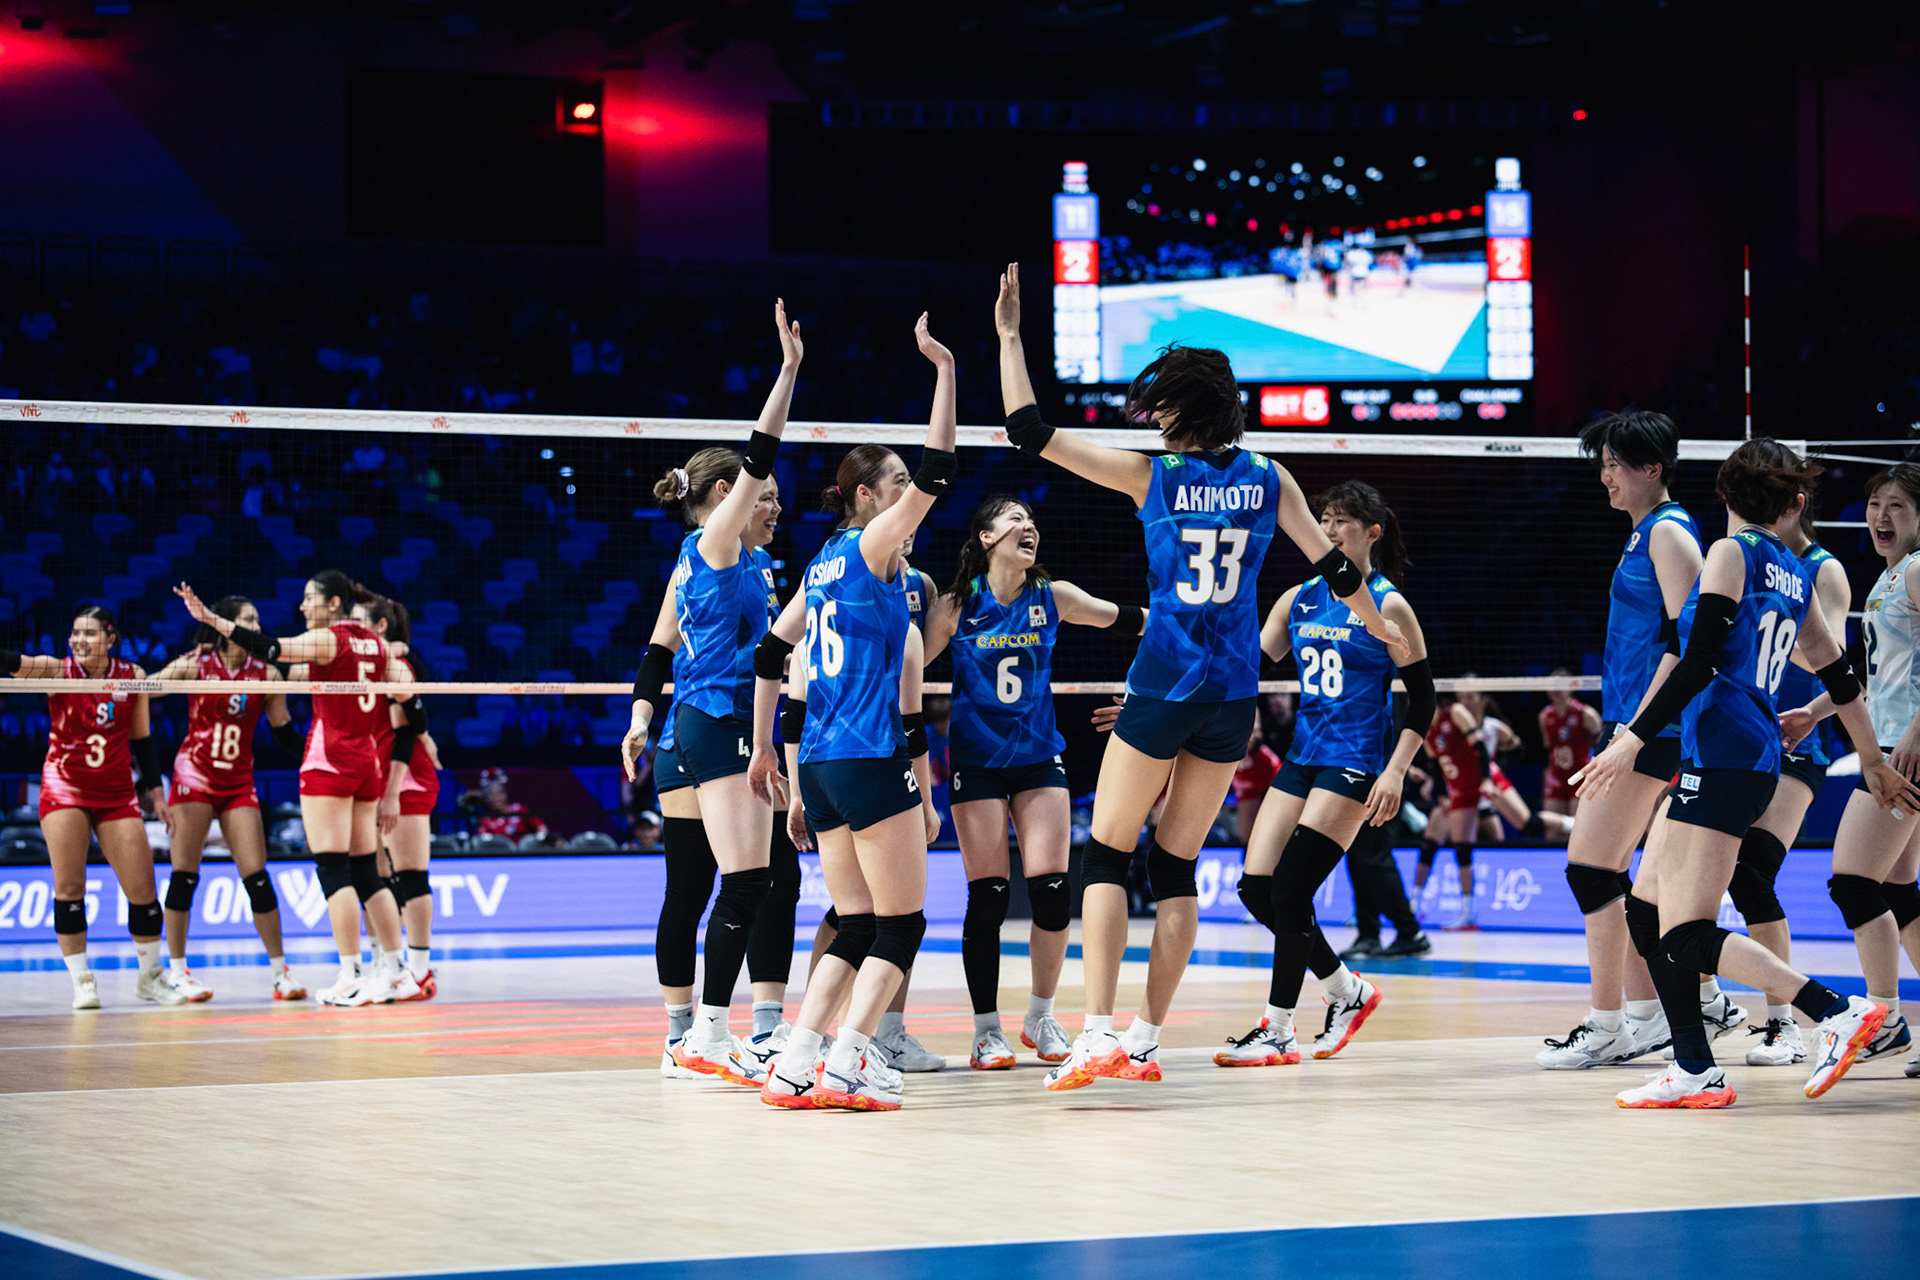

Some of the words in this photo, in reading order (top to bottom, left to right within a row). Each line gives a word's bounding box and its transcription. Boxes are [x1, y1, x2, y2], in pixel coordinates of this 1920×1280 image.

[1063, 249, 1091, 283] 2
[1494, 245, 1523, 279] 2
[1174, 485, 1264, 512] AKIMOTO
[1176, 528, 1250, 605] 33
[805, 600, 844, 681] 26
[976, 632, 1041, 648] CAPCOM
[1299, 624, 1351, 641] CAPCOM
[1756, 610, 1797, 695] 18
[358, 661, 376, 713] 5
[997, 656, 1022, 704] 6
[1301, 646, 1343, 698] 28
[85, 734, 107, 768] 3
[210, 722, 241, 761] 18
[953, 771, 961, 791] 6
[1682, 776, 1698, 789] TEL
[0, 879, 102, 929] 205
